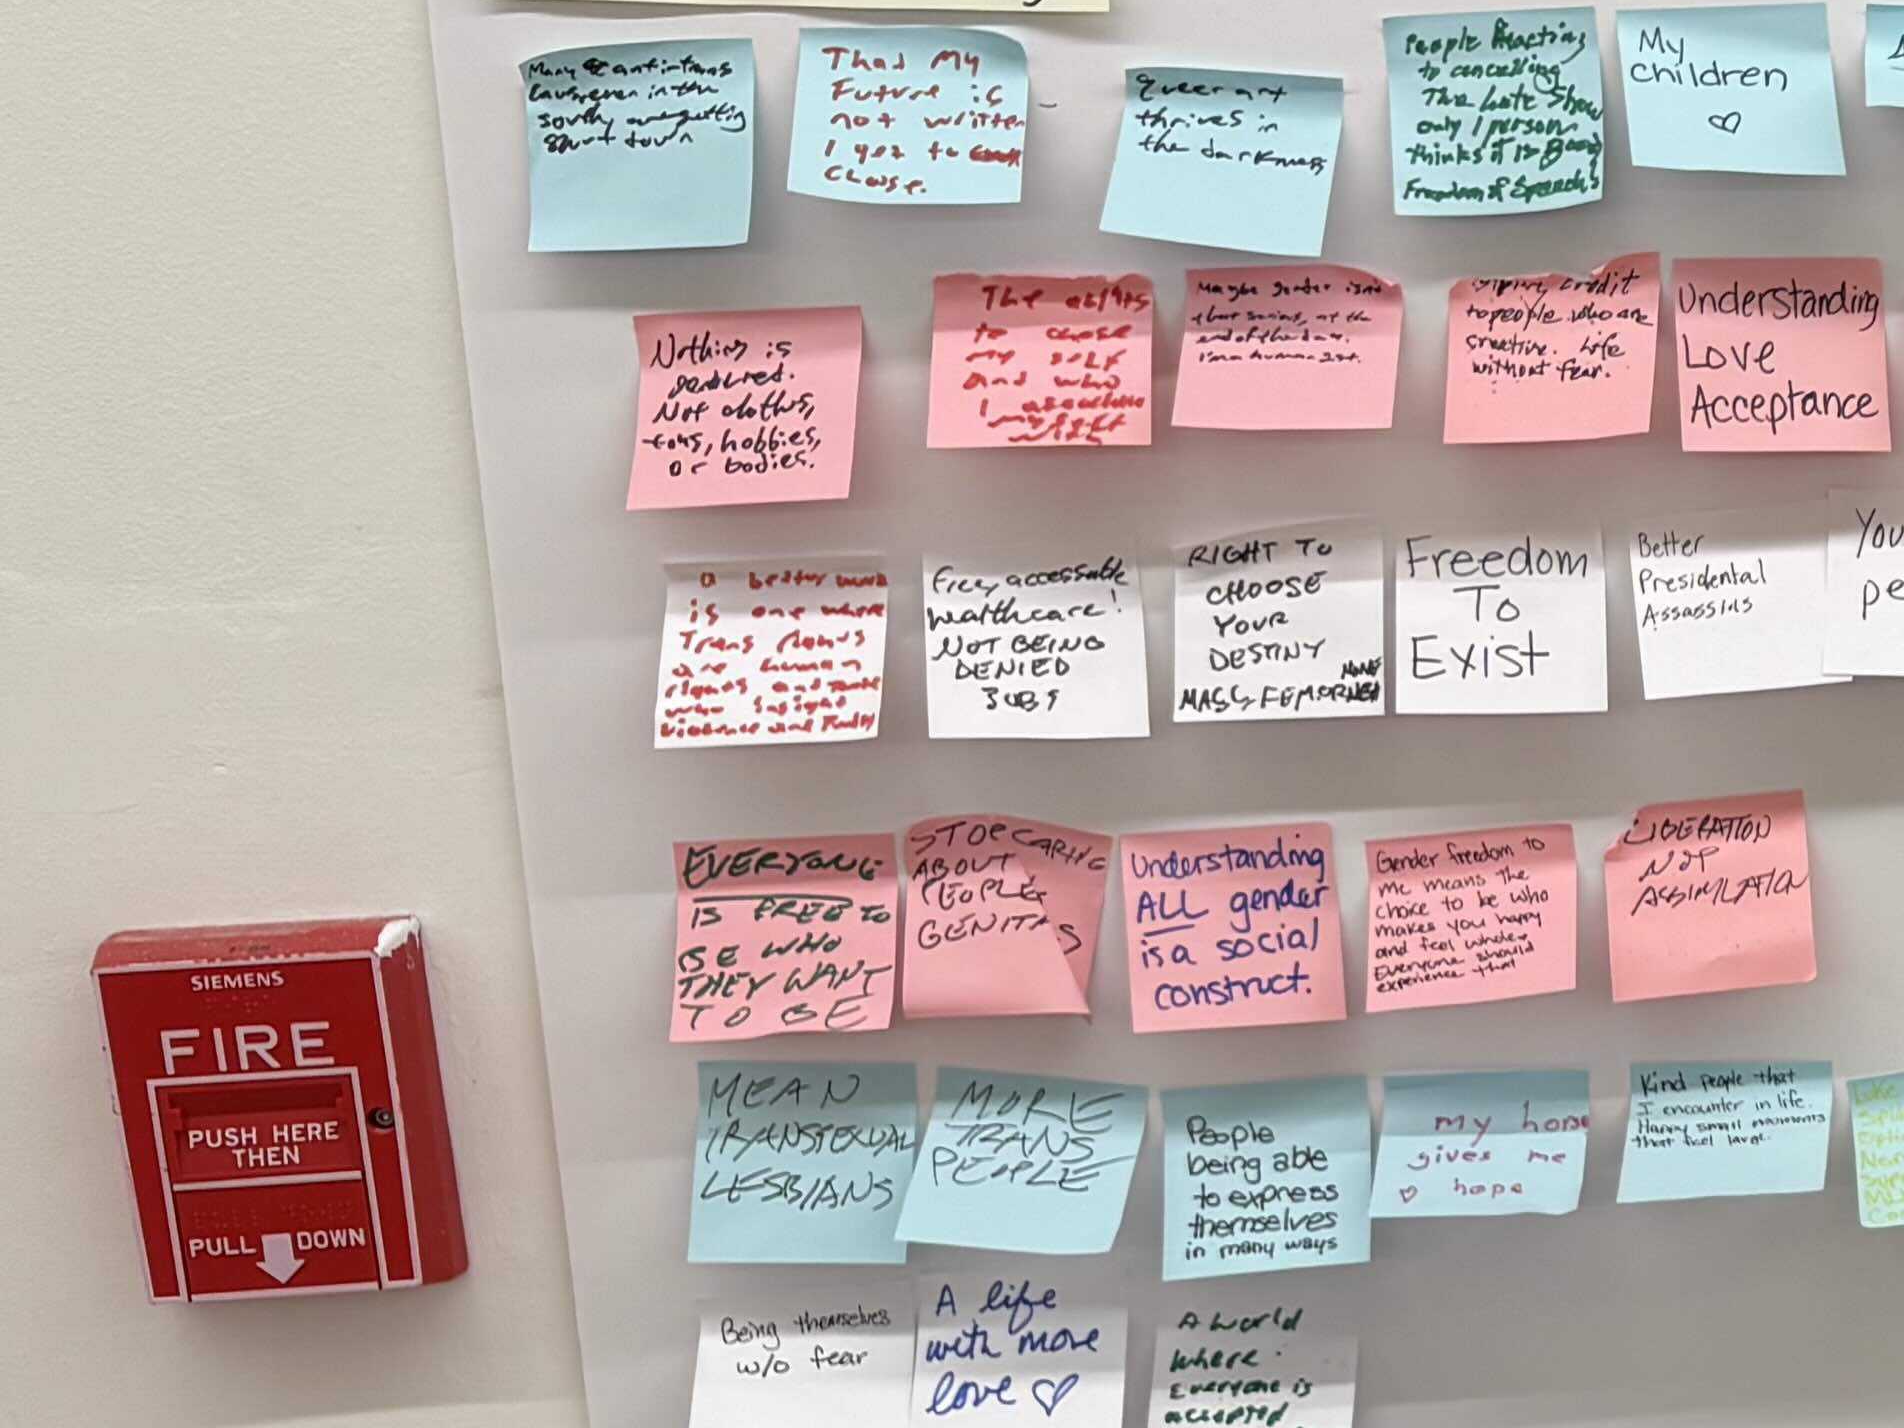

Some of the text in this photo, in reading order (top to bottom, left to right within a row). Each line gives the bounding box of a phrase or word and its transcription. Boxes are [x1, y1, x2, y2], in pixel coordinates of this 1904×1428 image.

[1638, 26, 1685, 68] My
[1630, 62, 1788, 93] children
[1678, 279, 1880, 332] Understanding
[1682, 333, 1776, 373] Love
[1691, 380, 1879, 434] Acceptance
[1407, 535, 1588, 579] Freedom
[1453, 585, 1520, 622] To
[1411, 630, 1550, 679] Exist
[1131, 833, 1325, 885] Understanding
[1136, 883, 1330, 933] ALL gender
[1216, 917, 1319, 961] social
[192, 971, 284, 992] SIEMENS
[1155, 962, 1313, 1011] construct.
[160, 1021, 335, 1075] FIRE
[188, 1121, 339, 1149] PUSH HERE
[1186, 1115, 1274, 1145] People
[232, 1146, 301, 1168] THEN
[1187, 1145, 1328, 1184] being able
[1192, 1183, 1339, 1211] to express
[189, 1227, 366, 1257] PULL DOWN
[1188, 1211, 1338, 1239] themselves
[1185, 1236, 1338, 1260] in many ways
[936, 1278, 1058, 1336] A life
[720, 1308, 891, 1351] Being themselves
[925, 1324, 1099, 1363] with more
[736, 1348, 869, 1379] w/o fear
[925, 1372, 1016, 1416] love
